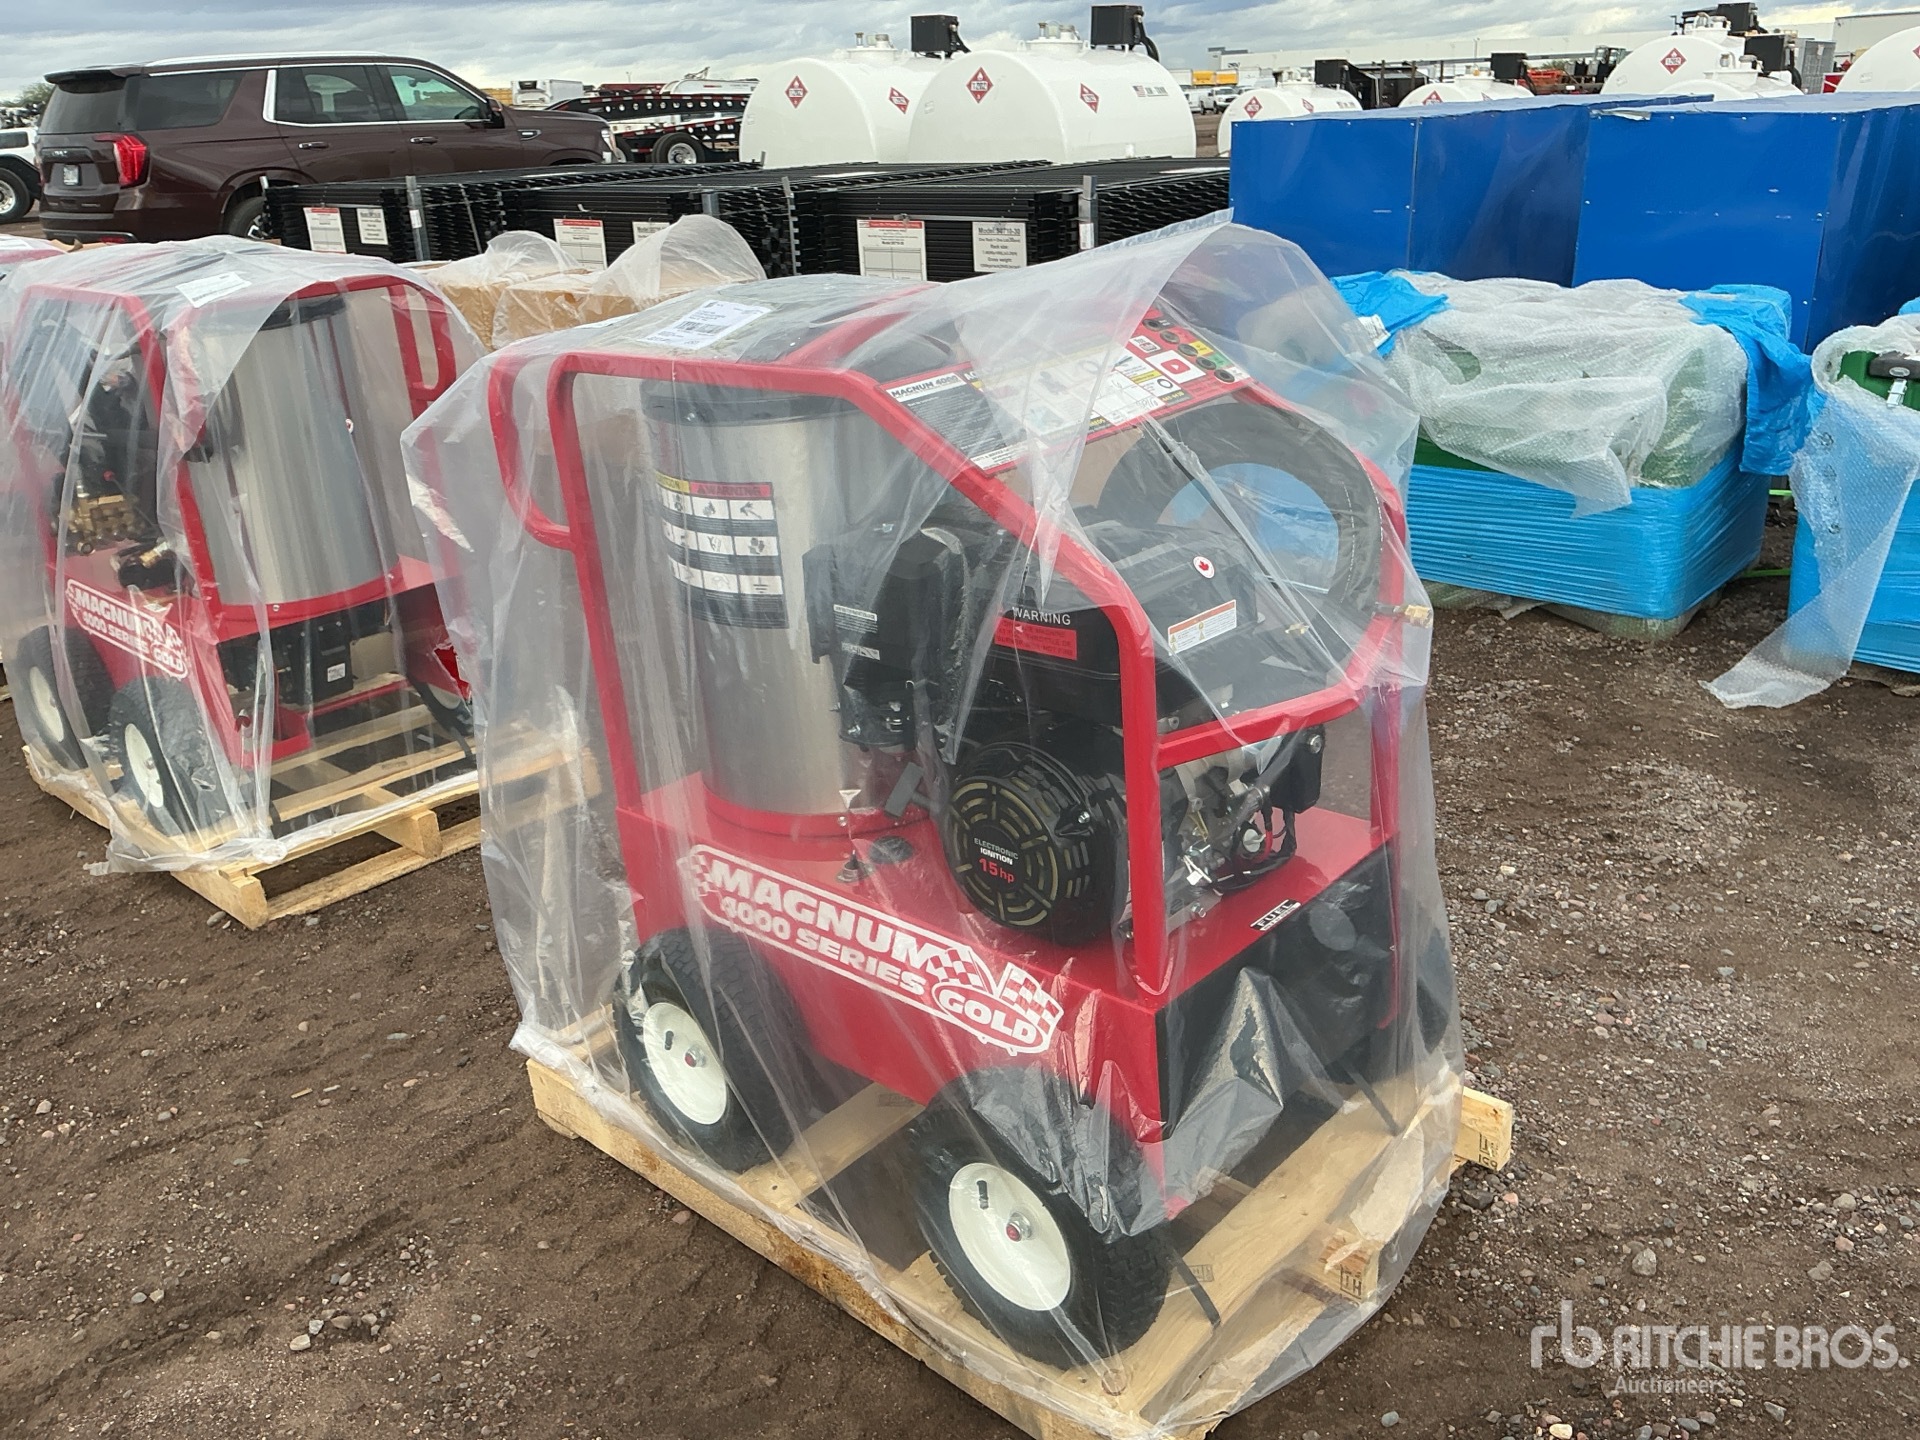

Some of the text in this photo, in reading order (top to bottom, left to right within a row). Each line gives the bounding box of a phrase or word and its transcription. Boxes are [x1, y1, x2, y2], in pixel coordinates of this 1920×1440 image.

[891, 381, 934, 398] MAGNUM
[1012, 606, 1072, 626] WARNING
[108, 623, 151, 655] SERIES
[152, 648, 184, 672] GOLD
[973, 837, 1019, 861] ELECTRONIC
[980, 846, 1014, 866] IGNITION
[708, 858, 939, 970] MAGNUM
[1256, 903, 1295, 928] FUEL
[719, 896, 929, 996] 4000 SERIES
[938, 988, 1038, 1043] GOLD
